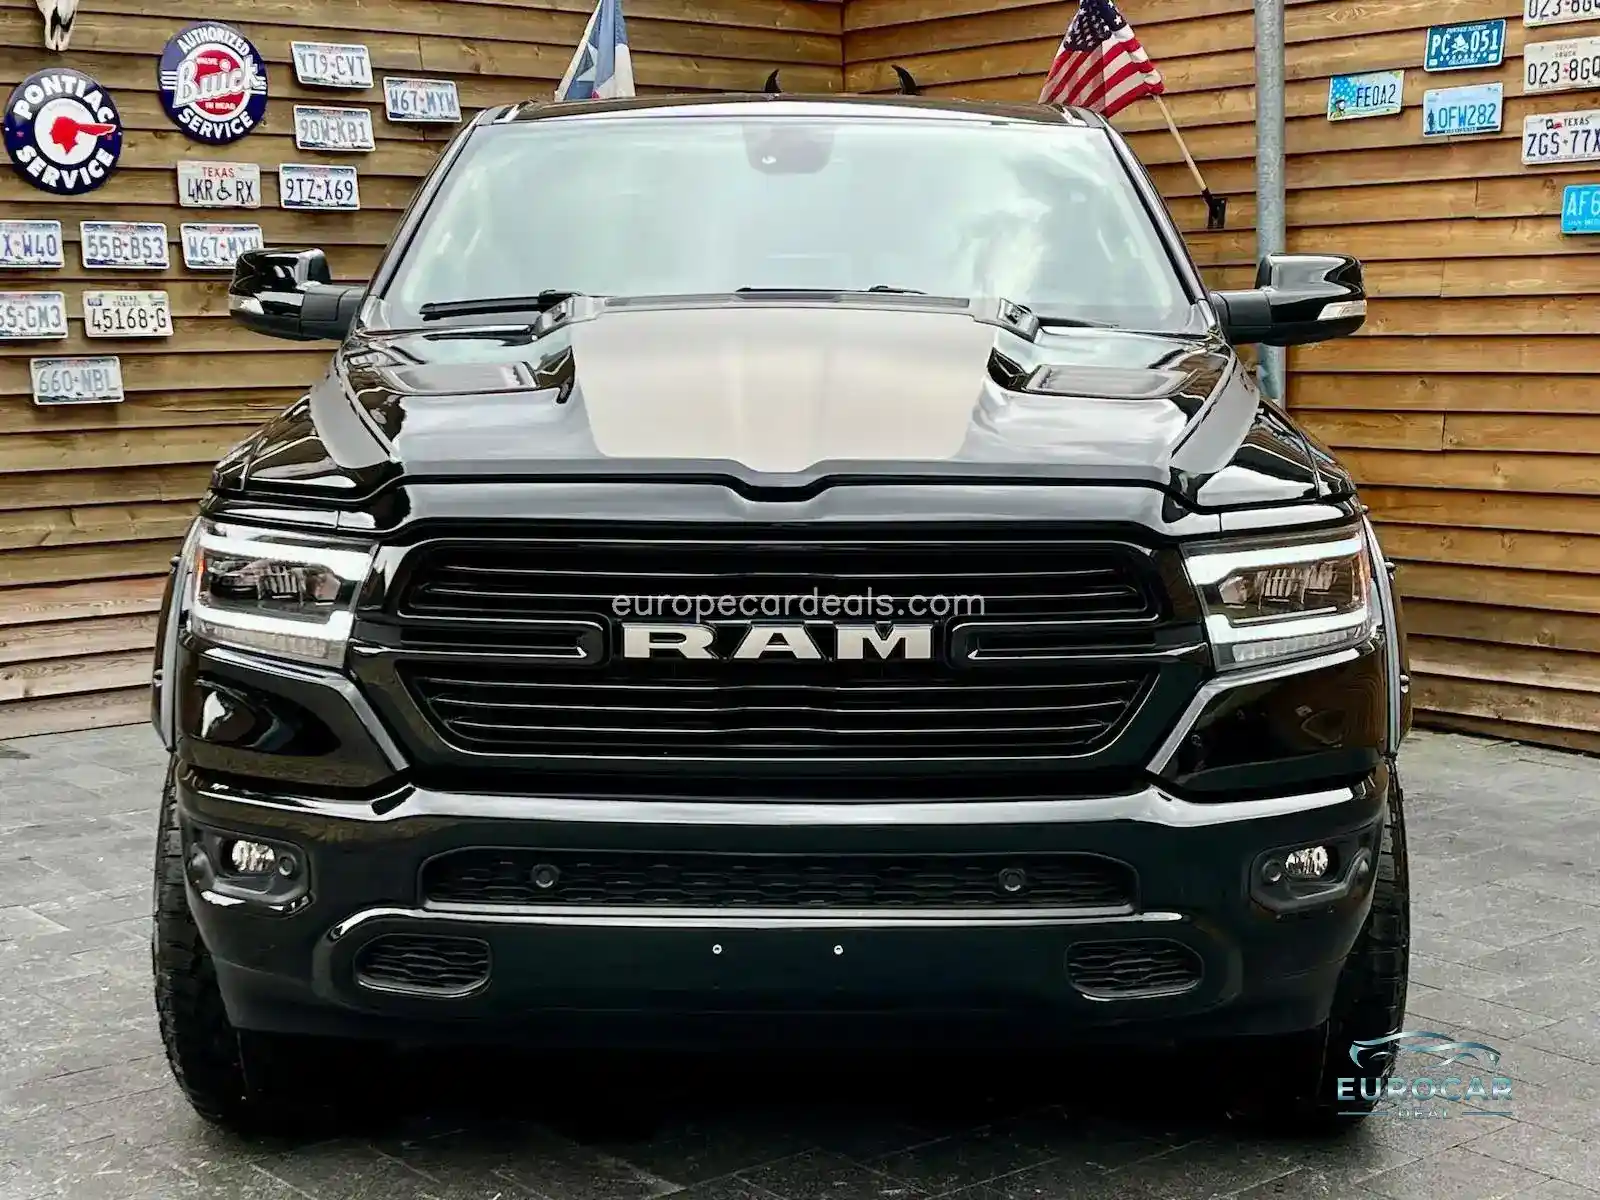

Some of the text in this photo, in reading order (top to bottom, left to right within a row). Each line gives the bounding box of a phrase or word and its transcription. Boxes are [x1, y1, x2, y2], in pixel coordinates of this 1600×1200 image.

[177, 26, 250, 56] AUTHORIZED
[1430, 29, 1499, 57] PC 051
[172, 54, 266, 109] Buick
[13, 75, 115, 123] PONTIAC
[178, 107, 254, 139] SERVICE
[1563, 116, 1591, 128] TEXAS
[16, 145, 115, 189] SERVICE
[202, 166, 235, 178] TEXAS
[187, 178, 256, 202] 4KR RX
[622, 620, 935, 660] RAM
